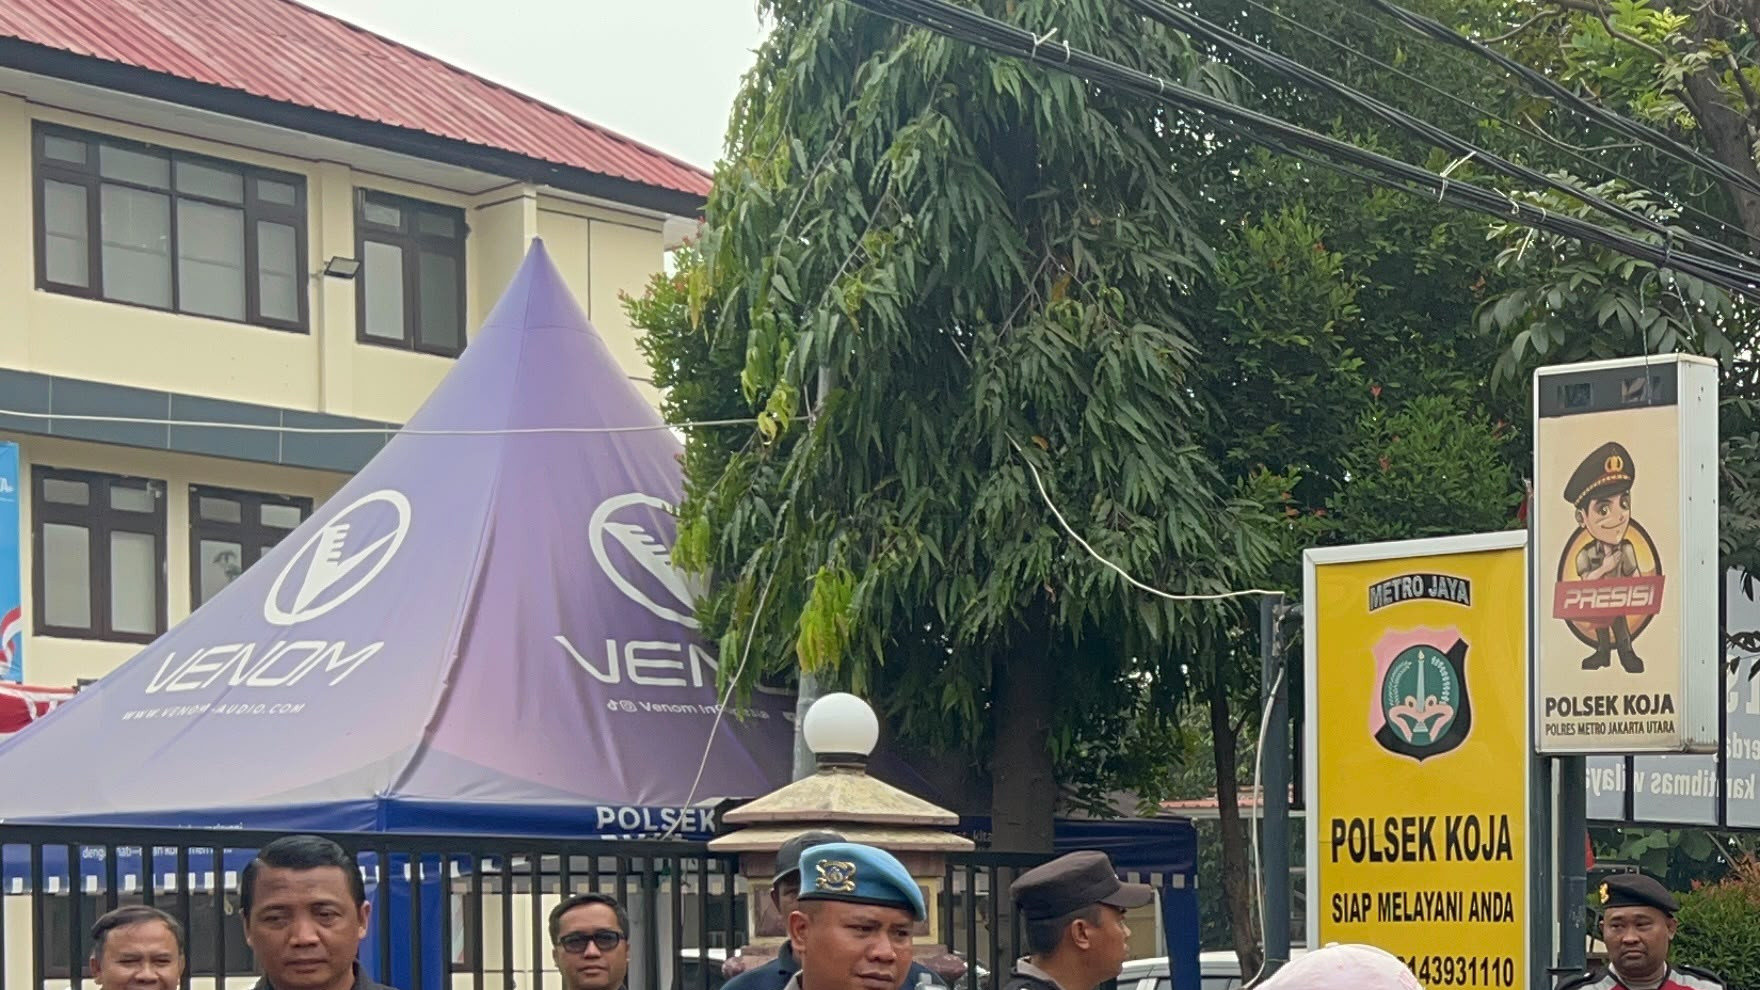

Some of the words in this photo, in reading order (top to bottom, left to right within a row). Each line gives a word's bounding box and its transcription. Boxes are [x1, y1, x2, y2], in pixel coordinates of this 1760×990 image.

[1371, 575, 1424, 610] METRO
[1428, 575, 1469, 605] JAYA
[1563, 584, 1655, 609] PRESISI
[145, 640, 384, 693] VENOM
[554, 635, 745, 690] VEN
[639, 701, 698, 715] Venom
[1545, 695, 1619, 718] POLSEK
[1623, 693, 1675, 715] KOJA
[1545, 722, 1576, 737] POLRES
[1577, 721, 1606, 736] METRO
[1608, 720, 1645, 735] JAKARTA
[1647, 720, 1676, 734] UTARA
[596, 806, 716, 833] POLSEK
[1332, 816, 1437, 864] POLSEK
[1445, 814, 1514, 862] KOJA
[1332, 892, 1372, 924] SIAP
[1377, 891, 1463, 923] MELAYANI
[1468, 891, 1515, 923] ANDA
[1397, 956, 1514, 988] 143931110
